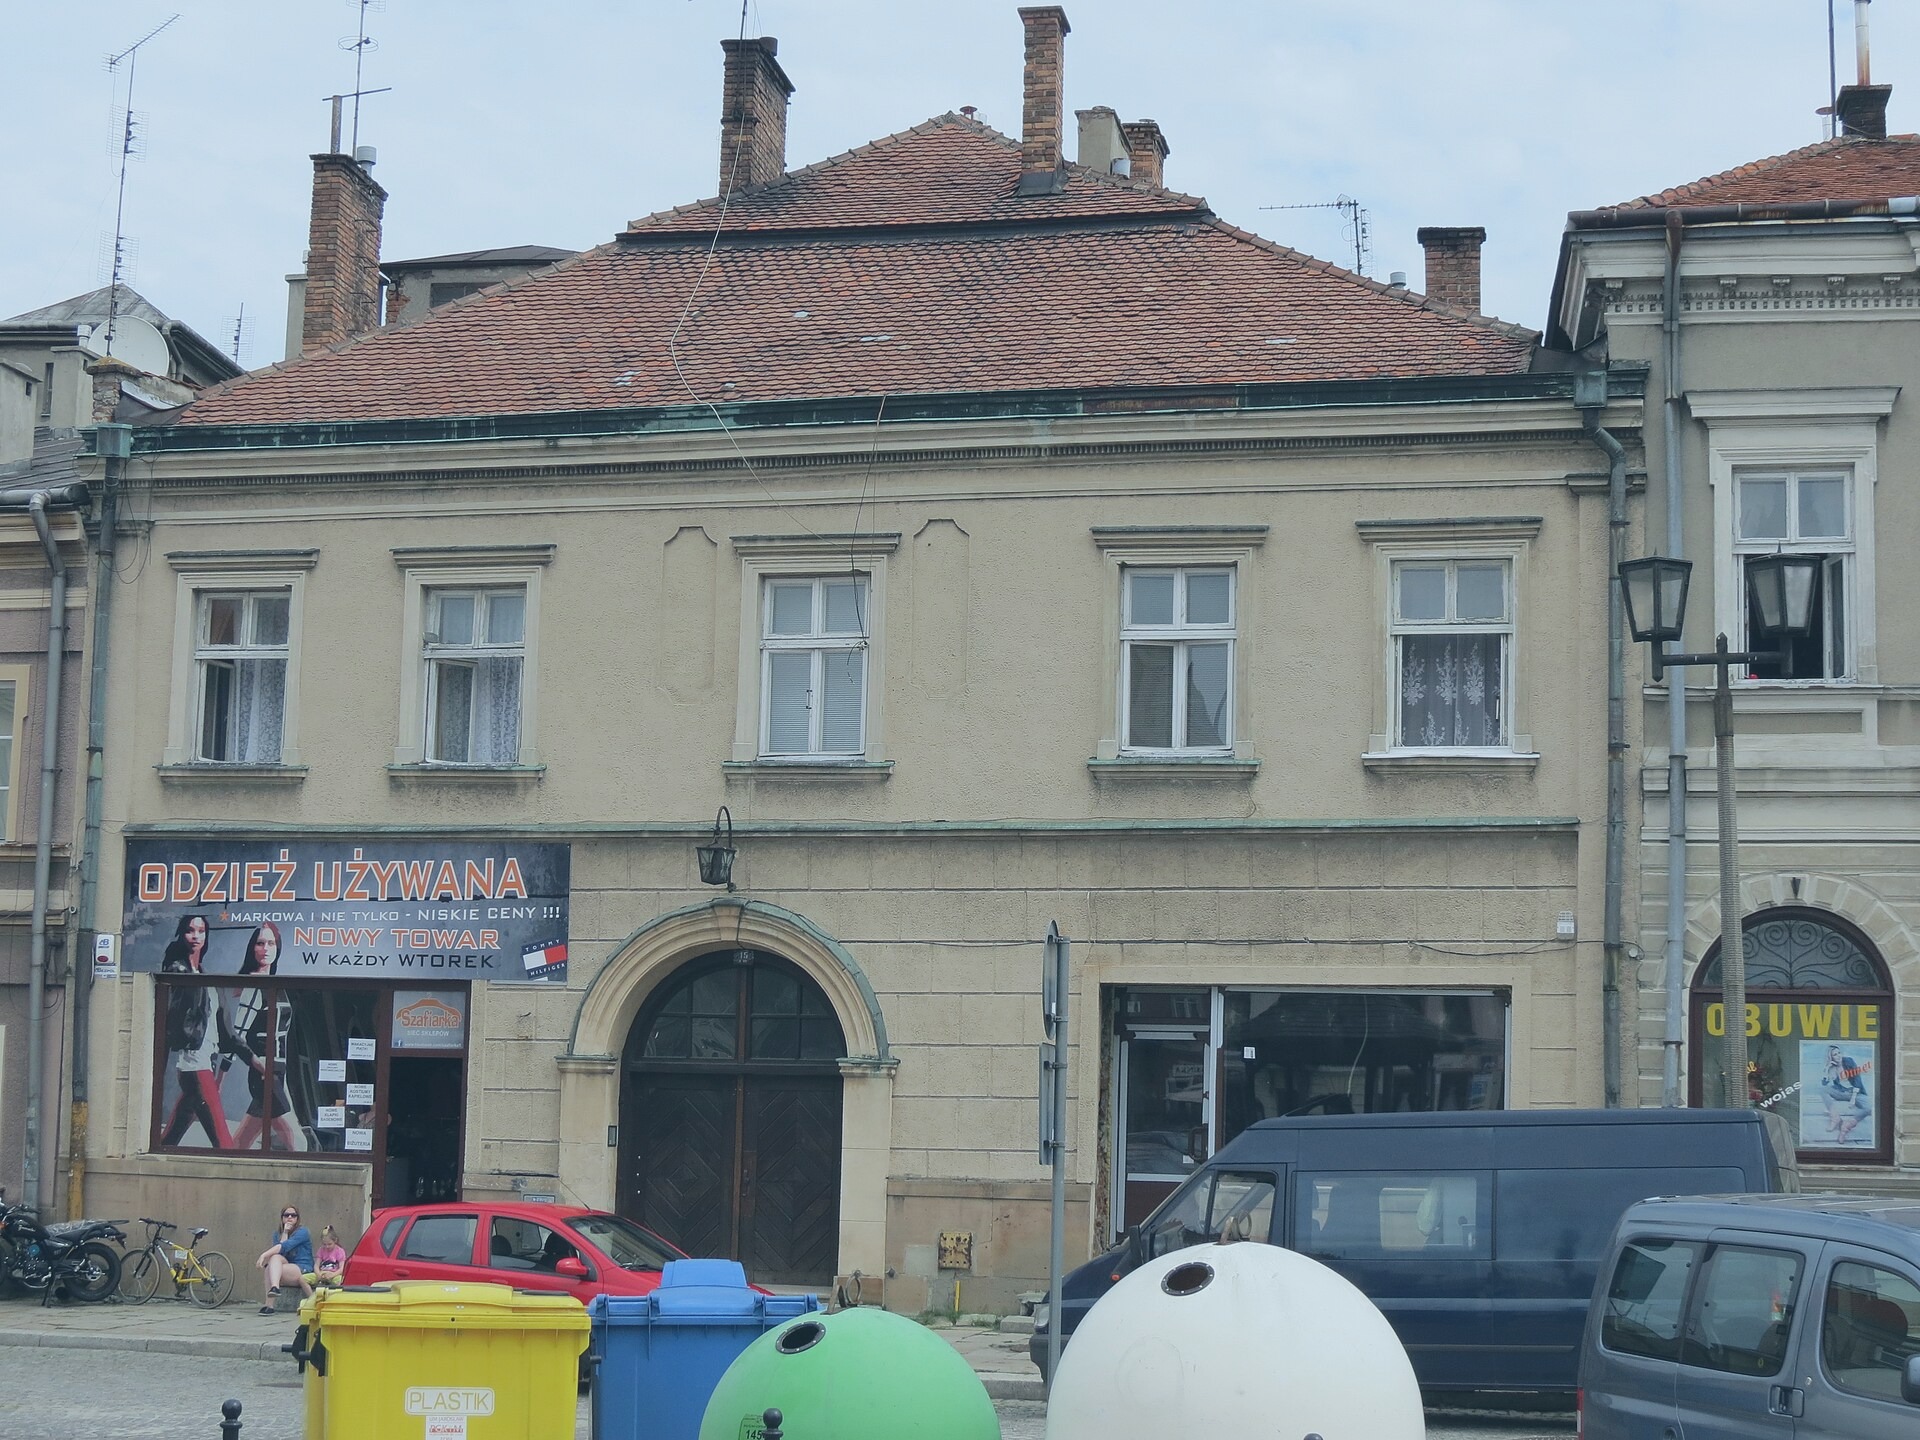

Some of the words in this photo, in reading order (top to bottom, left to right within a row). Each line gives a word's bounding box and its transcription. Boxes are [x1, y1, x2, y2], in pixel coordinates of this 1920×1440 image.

[139, 848, 297, 902] ODZIEŻ
[314, 847, 528, 901] UŻYWANA
[231, 911, 304, 922] MARKOWA
[310, 911, 314, 921] I
[321, 911, 345, 921] NIE
[352, 911, 399, 921] TYLKO
[418, 909, 479, 921] NISKIE
[487, 907, 536, 920] CENY
[543, 906, 560, 919] !!!
[294, 927, 384, 948] NOWY
[391, 928, 501, 950] TOWAR
[525, 939, 560, 952] TOMMY
[302, 952, 319, 965] W
[328, 950, 389, 966] KAŻDY
[399, 954, 494, 968] WTOREK
[530, 963, 566, 976] HILFIGER
[400, 1009, 460, 1028] Szafiarka
[1706, 1003, 1878, 1039] OBUWIE
[1759, 1081, 1803, 1109] wojas
[409, 1391, 489, 1411] PLASTIK
